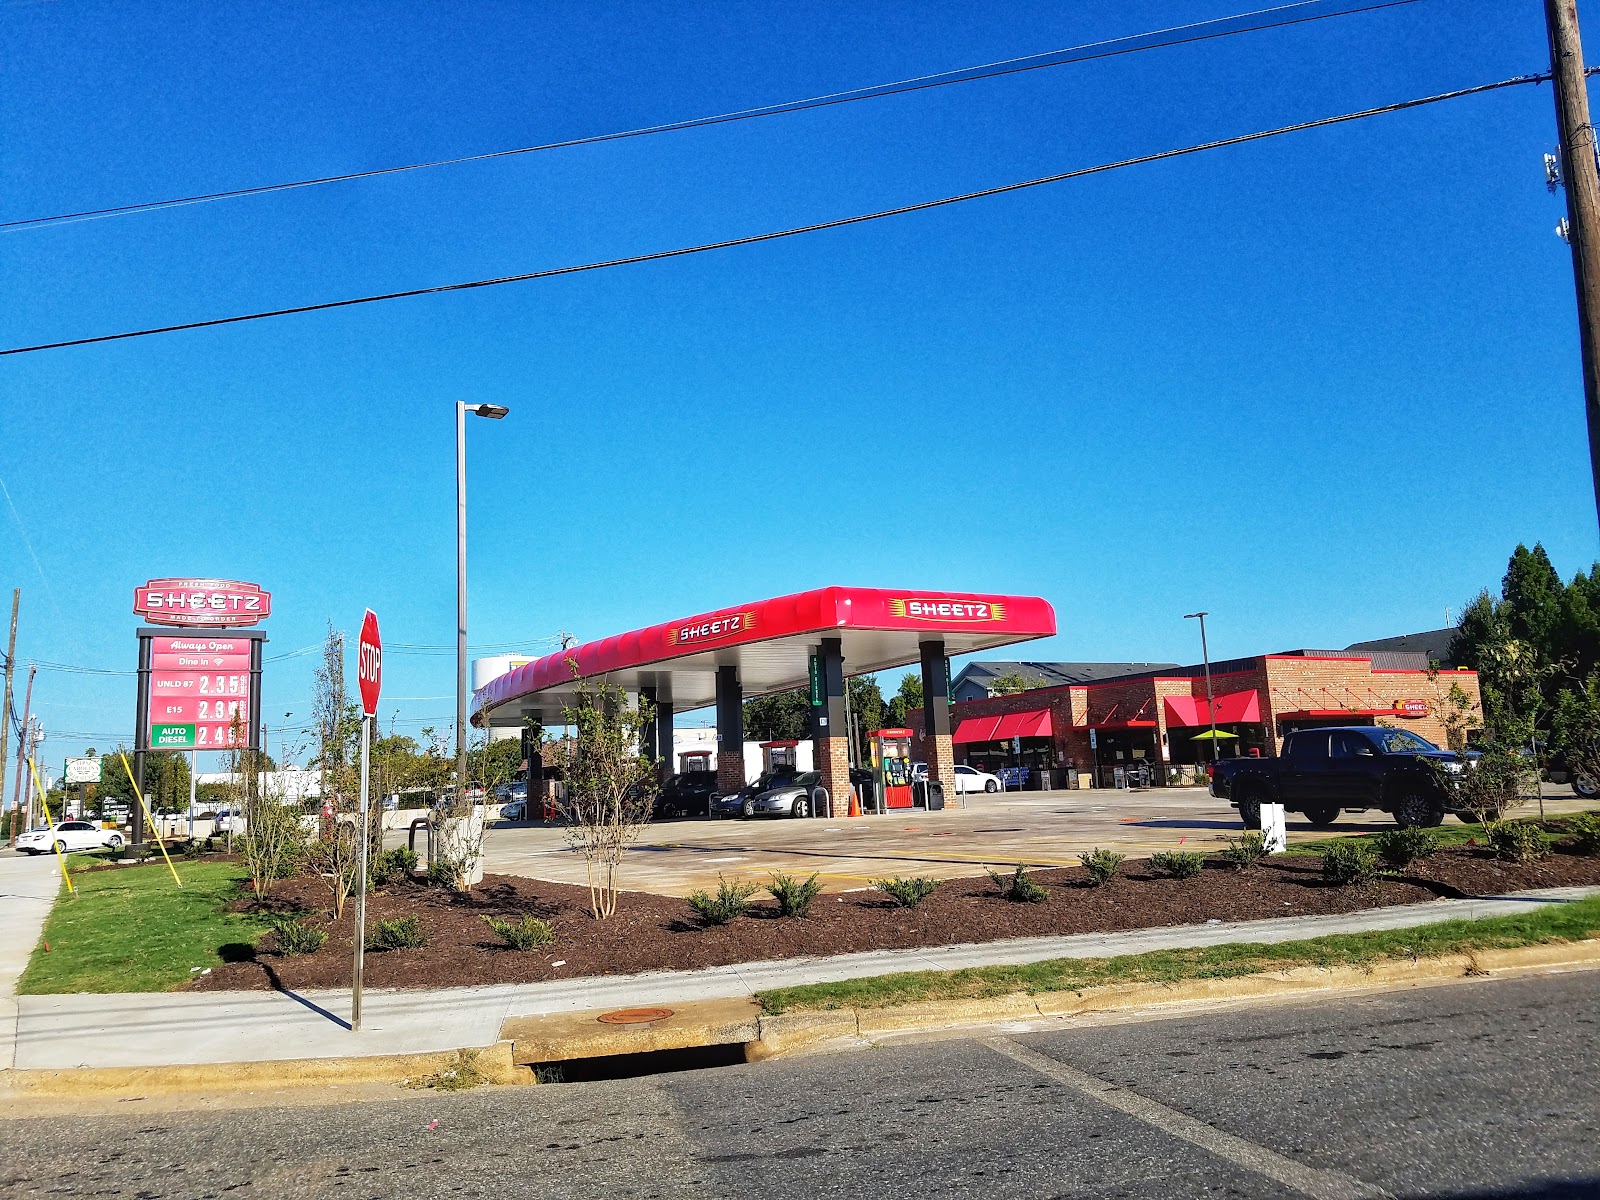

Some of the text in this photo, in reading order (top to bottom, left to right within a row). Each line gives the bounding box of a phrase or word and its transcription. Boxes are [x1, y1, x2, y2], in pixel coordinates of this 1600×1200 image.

[146, 592, 260, 610] SHEETZ
[910, 602, 988, 617] SHEETZ
[680, 616, 740, 642] SHEETZ
[170, 640, 234, 652] Always Open
[360, 640, 381, 683] STOP
[157, 680, 182, 688] UNLD
[182, 680, 194, 688] 87
[199, 675, 239, 694] 2.35
[166, 706, 183, 714] E15
[161, 727, 187, 735] AUTO
[158, 736, 188, 744] DIESEL
